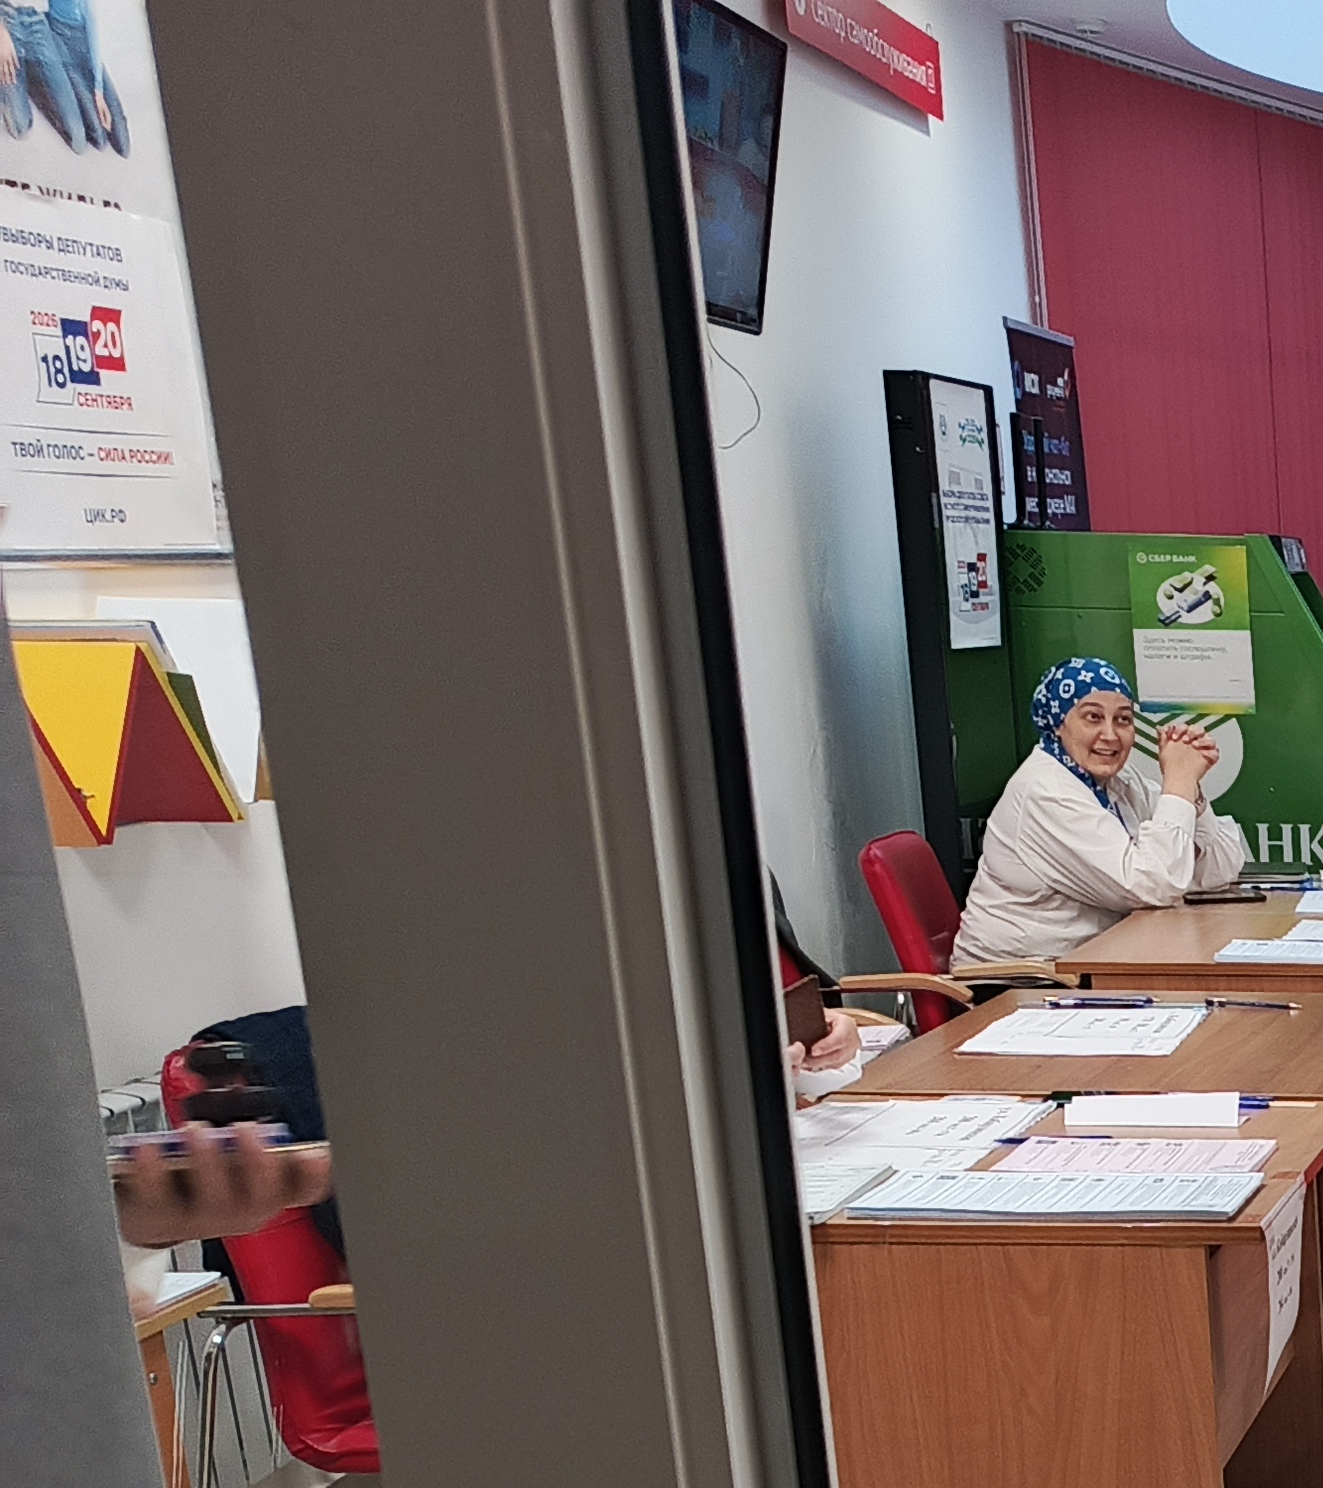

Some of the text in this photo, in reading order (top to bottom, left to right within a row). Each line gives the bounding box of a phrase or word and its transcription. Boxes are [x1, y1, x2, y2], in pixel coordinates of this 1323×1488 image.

[56, 235, 123, 263] ДЕПУТАТОВ
[4, 258, 102, 288] ГОСУДАРСТВЕННОЙ
[30, 310, 58, 329] 2026
[40, 319, 124, 389] 18 19 20
[77, 391, 134, 412] СЕНТЯБРЯ
[11, 438, 45, 460] ТВОЙ
[46, 443, 85, 461] ГОЛОС
[97, 446, 127, 463] СИЛА
[84, 507, 127, 526] ЦИК.РФ
